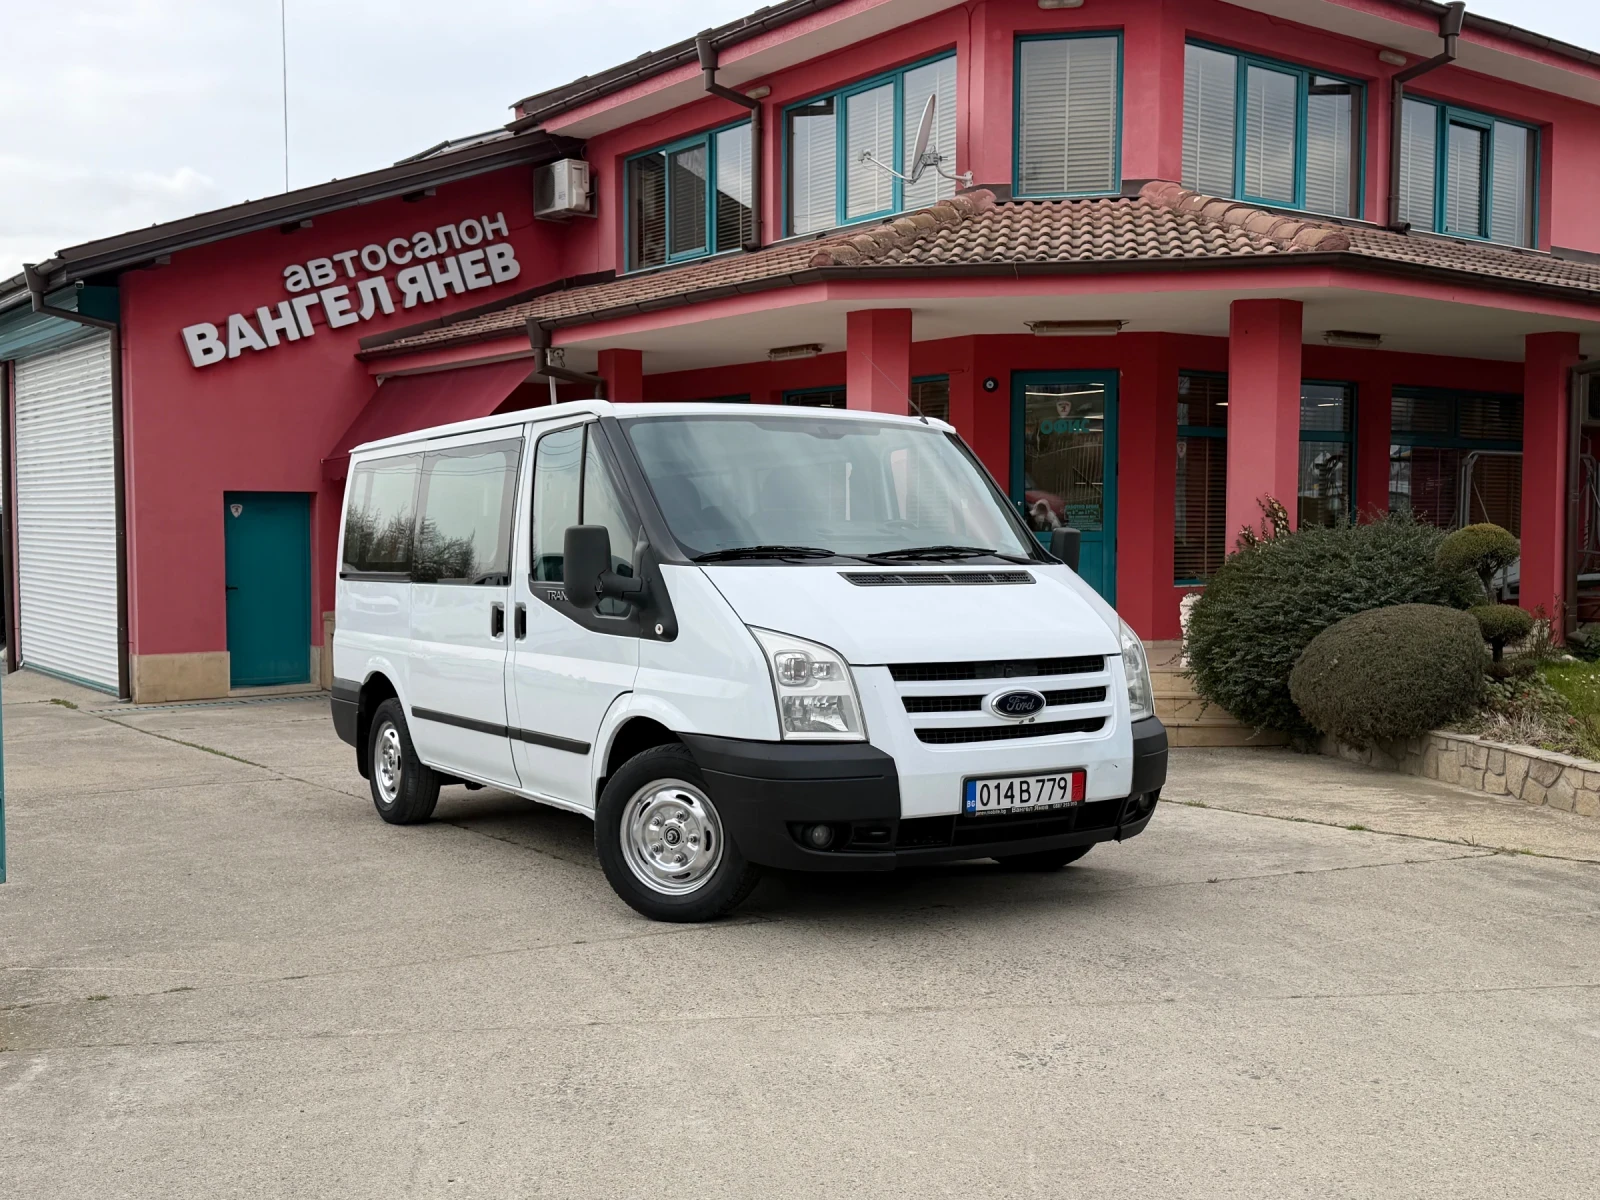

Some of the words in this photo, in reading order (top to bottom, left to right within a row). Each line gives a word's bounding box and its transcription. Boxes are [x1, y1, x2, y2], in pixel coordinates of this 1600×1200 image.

[283, 212, 509, 292] автосалон
[181, 275, 396, 368] ВАНГЕЛ
[396, 242, 521, 309] ЯНЕВ
[1040, 418, 1090, 435] ОФИС
[547, 590, 569, 601] TRAN
[1006, 695, 1035, 711] Ford
[966, 800, 976, 808] BG
